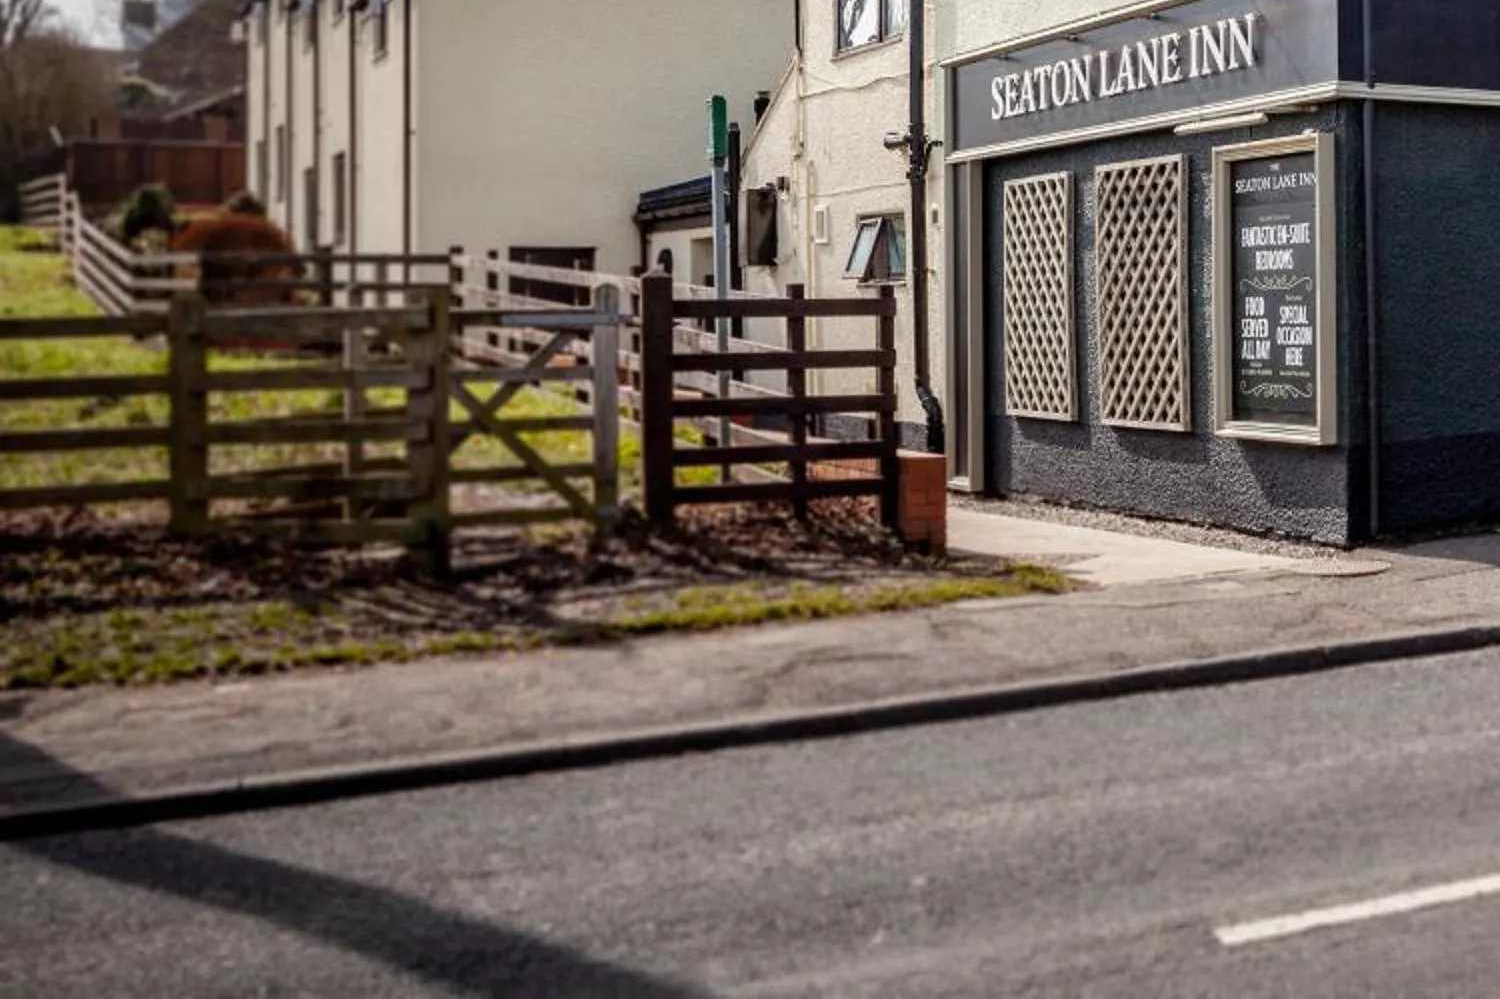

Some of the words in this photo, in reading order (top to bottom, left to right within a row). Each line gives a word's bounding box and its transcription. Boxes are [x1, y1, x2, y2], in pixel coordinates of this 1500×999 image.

[991, 54, 1093, 120] SEATON
[1099, 32, 1183, 98] LANE
[1188, 12, 1256, 78] INN
[1235, 176, 1271, 194] SEATON
[1272, 173, 1297, 191] LANE
